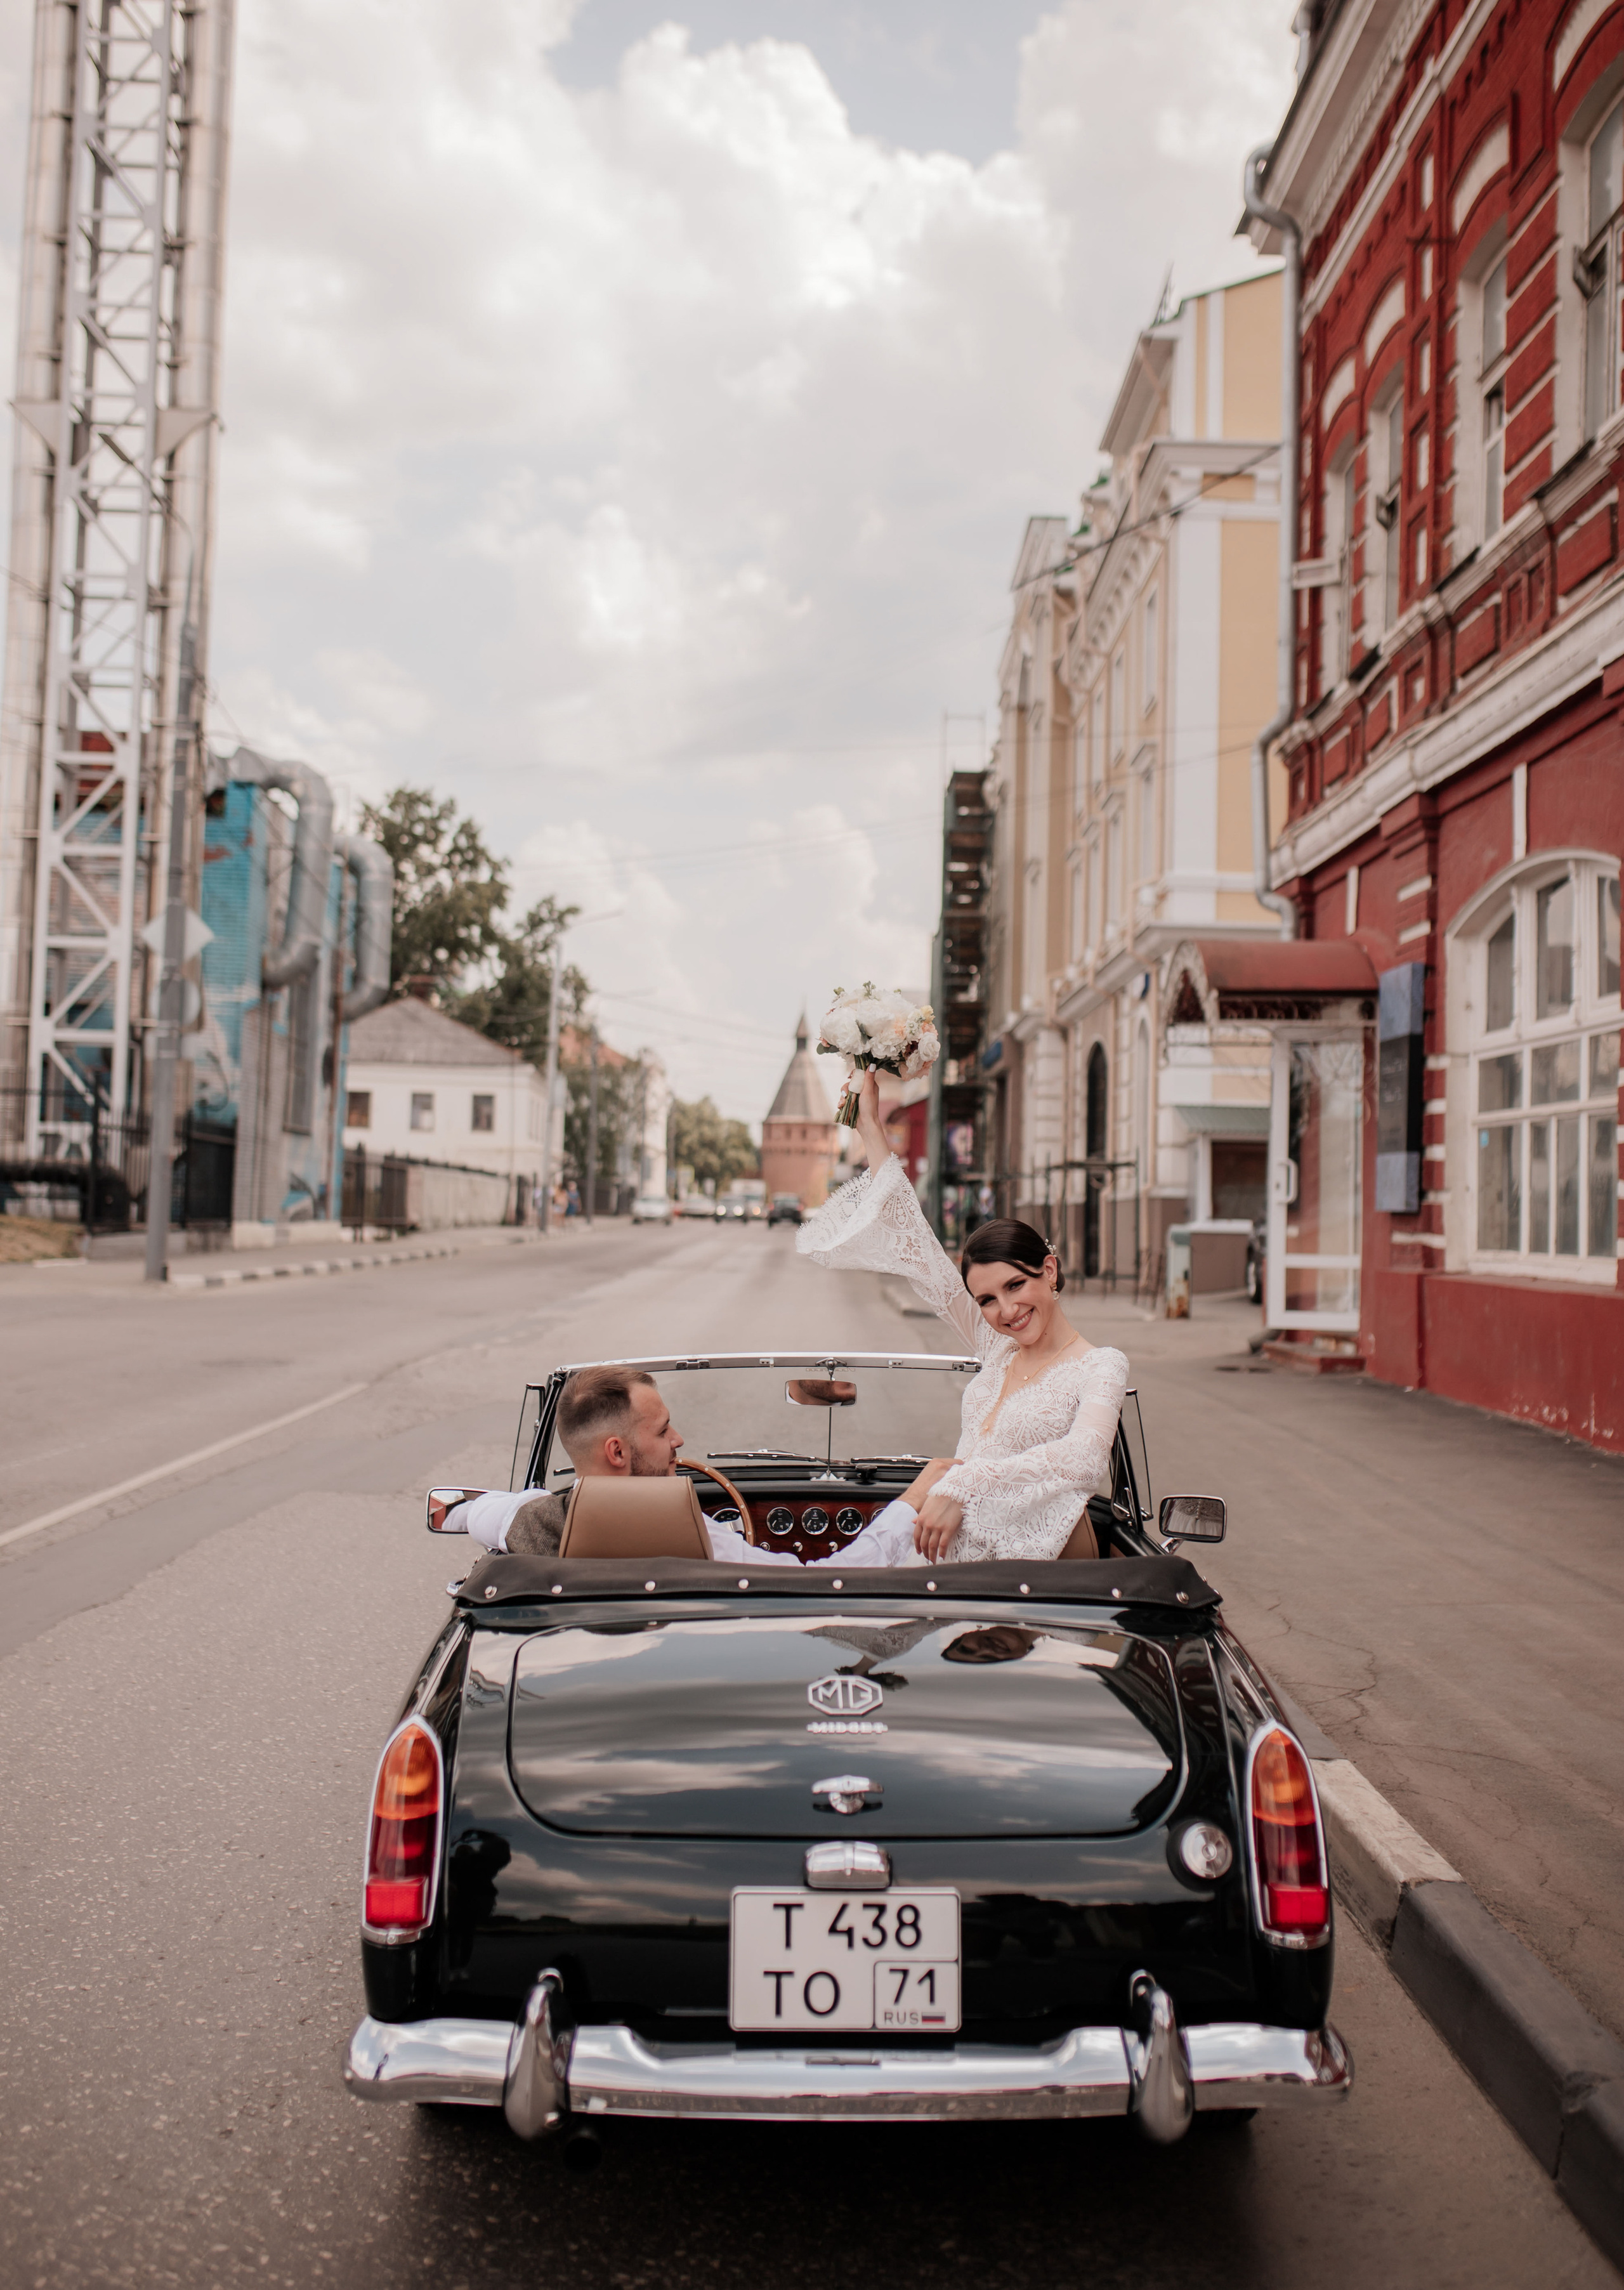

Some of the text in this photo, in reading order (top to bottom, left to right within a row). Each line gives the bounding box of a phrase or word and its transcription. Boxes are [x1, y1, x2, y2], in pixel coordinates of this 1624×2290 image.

[818, 1679, 873, 1710] MG
[811, 1721, 884, 1734] MIDGET
[828, 1903, 922, 1951] 438
[889, 1968, 936, 2006] 71
[884, 2011, 919, 2025] RUS
